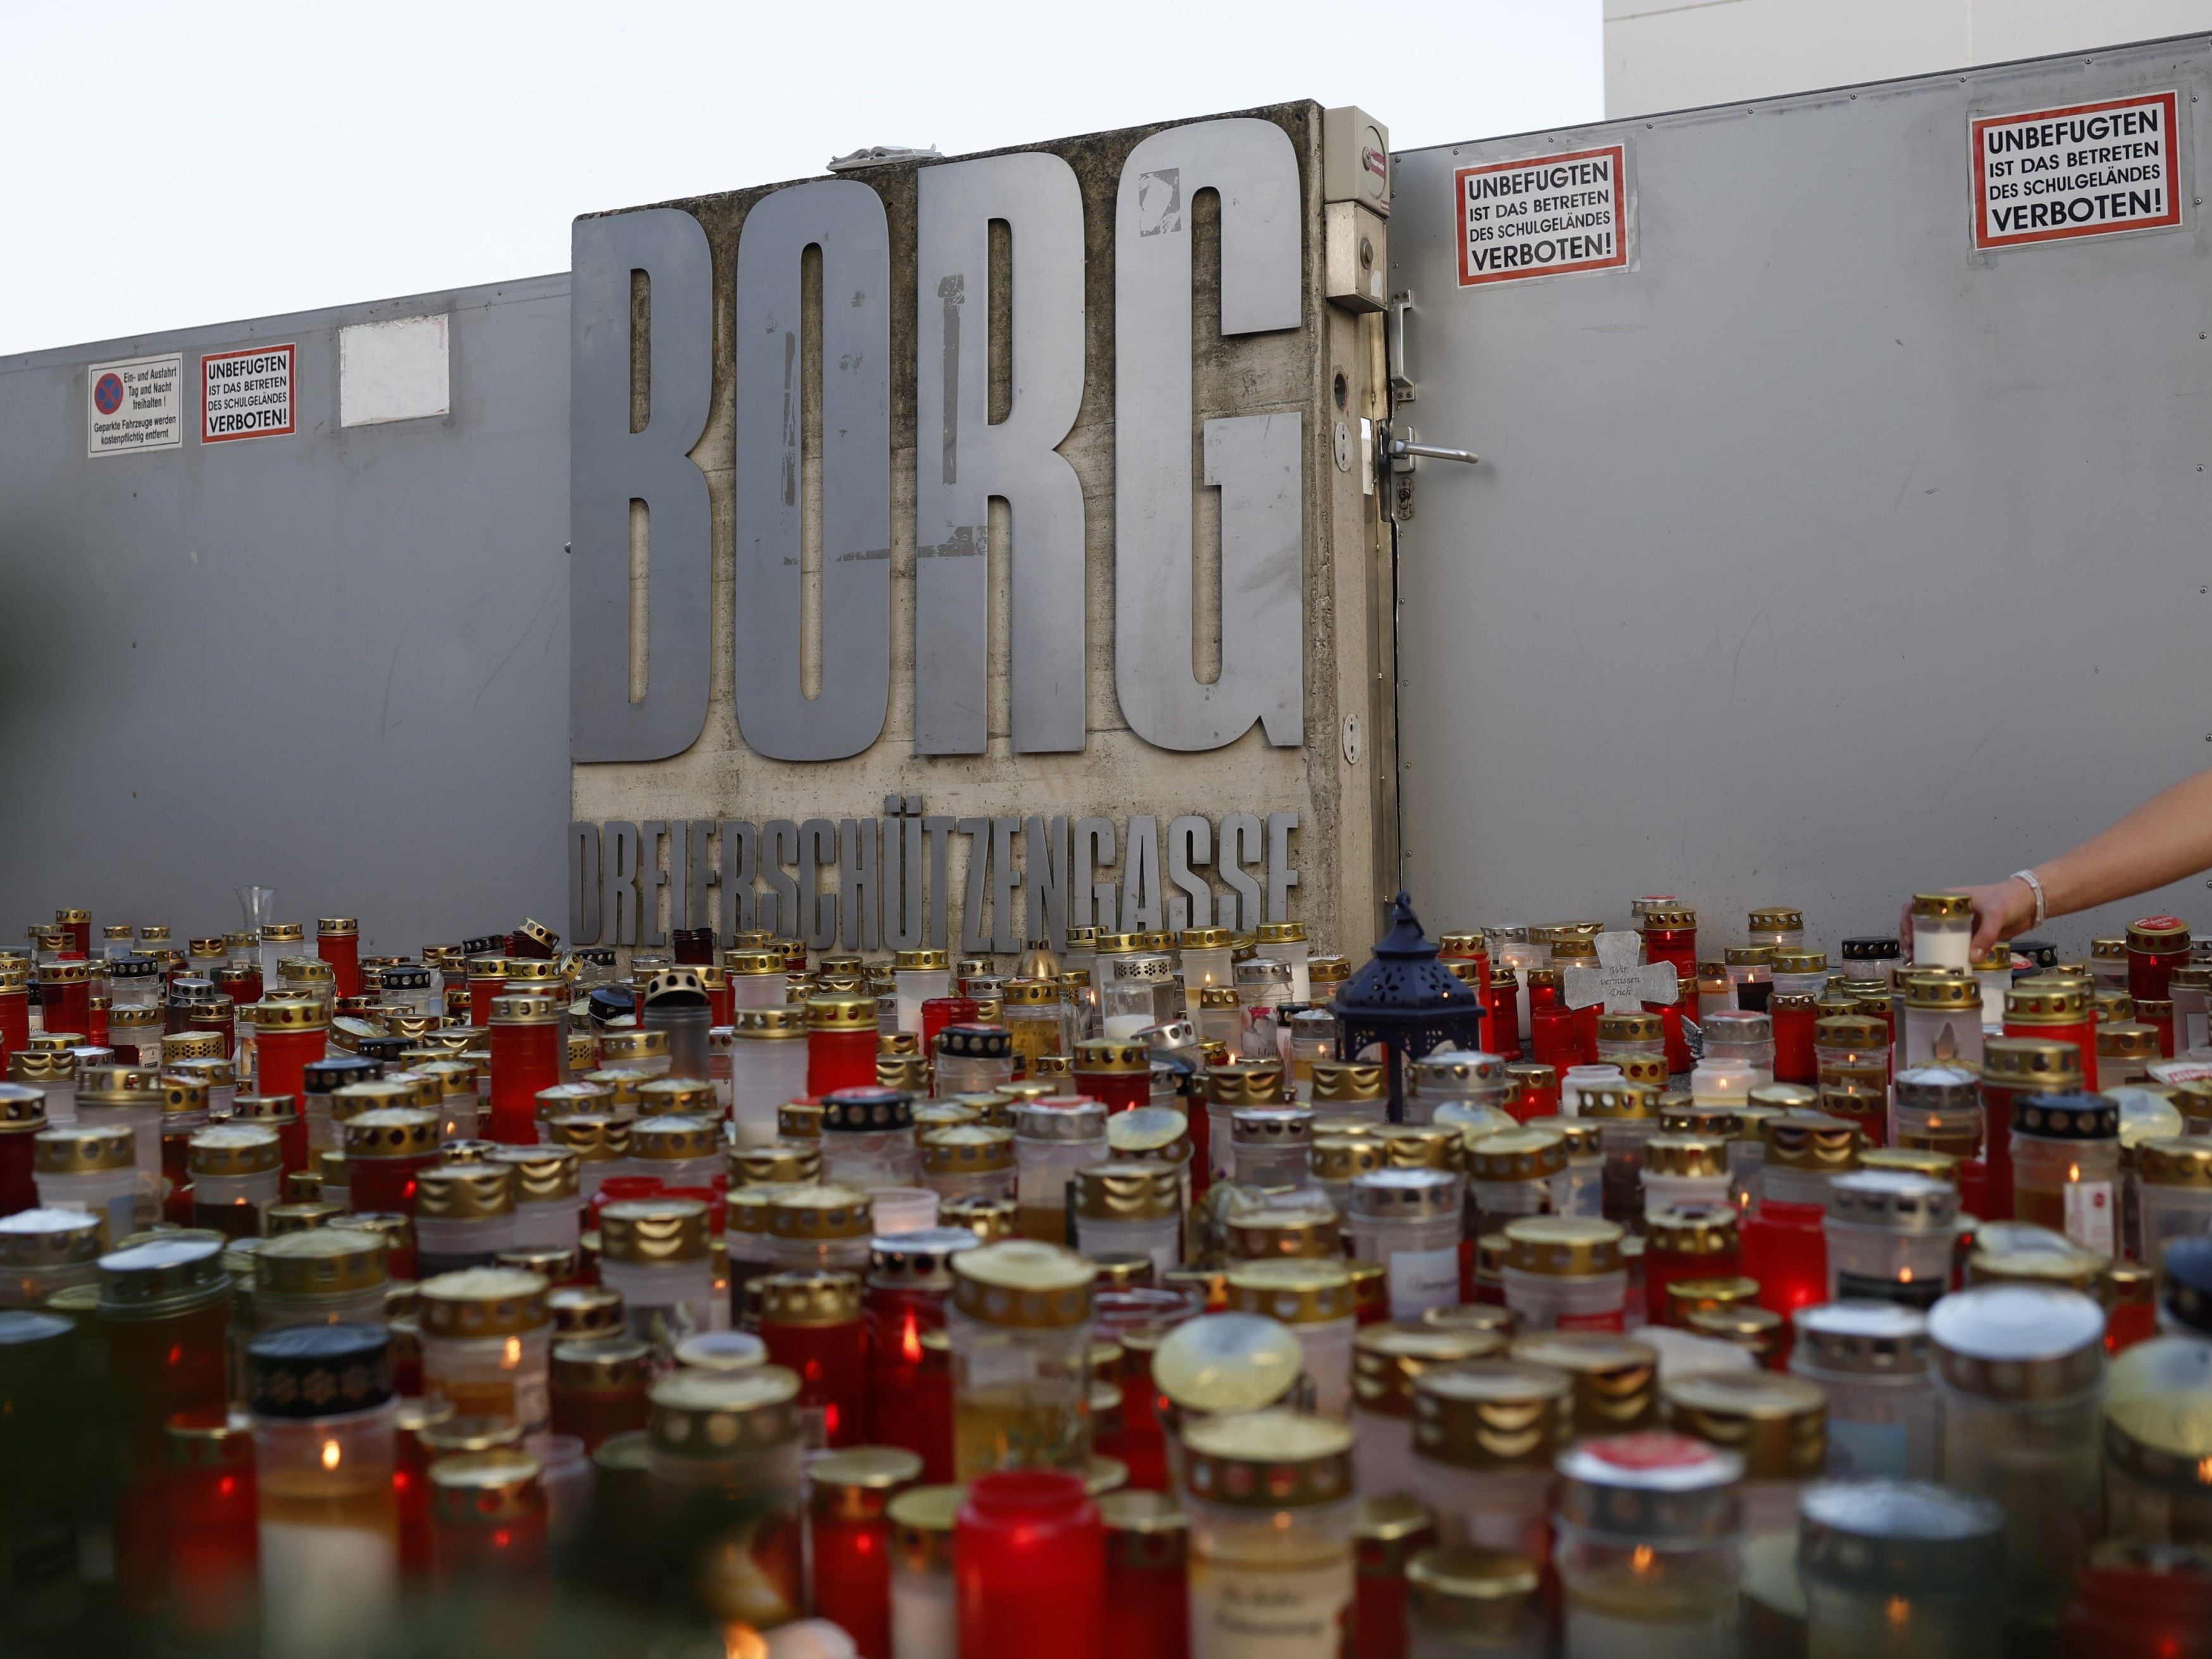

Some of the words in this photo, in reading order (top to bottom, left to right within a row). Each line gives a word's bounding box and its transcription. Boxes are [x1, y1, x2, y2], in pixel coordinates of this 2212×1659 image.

[1989, 109, 2158, 154] UNBEFUGTEN
[1989, 161, 2014, 178] IST
[2021, 154, 2060, 174] DAS
[2066, 140, 2159, 168] BETRETEN
[1469, 161, 1608, 200] UNBEFUGTEN
[1990, 183, 2018, 200] DES
[2023, 164, 2160, 196] SCHULGELÄNDES
[1469, 206, 1489, 221] IST
[1496, 201, 1527, 218] DAS
[1534, 189, 1609, 213] BETRETEN
[1991, 188, 2161, 232] VERBOTEN!
[1470, 227, 1493, 242] DES
[1498, 211, 1610, 239] SCHULGELÄNDES
[1472, 232, 1611, 271] VERBOTEN!
[124, 372, 135, 383] Ein-
[137, 370, 149, 381] und
[151, 366, 177, 380] Ausfahrt
[209, 355, 287, 380] UNBEFUGTEN
[128, 385, 139, 397] Tag
[140, 384, 151, 394] und
[154, 382, 171, 392] Nacht
[209, 385, 220, 396] IST
[223, 382, 241, 394] DAS
[244, 376, 287, 390] BETRETEN
[133, 397, 162, 410] freihalten
[208, 399, 221, 411] DES
[224, 392, 287, 409] SCHULGELÄNDES
[94, 421, 120, 433] Geparkte
[122, 418, 152, 429] Fahrzeuge
[154, 415, 176, 425] werden
[209, 408, 287, 433] VERBOTEN!
[101, 431, 144, 445] kostenpflichtig
[146, 429, 168, 440] entfernt
[571, 117, 1303, 764] BORG
[569, 794, 1299, 954] DREIERSCHÜTZENGASSE
[1600, 976, 1639, 985] vermissen
[1610, 987, 1631, 997] Dich
